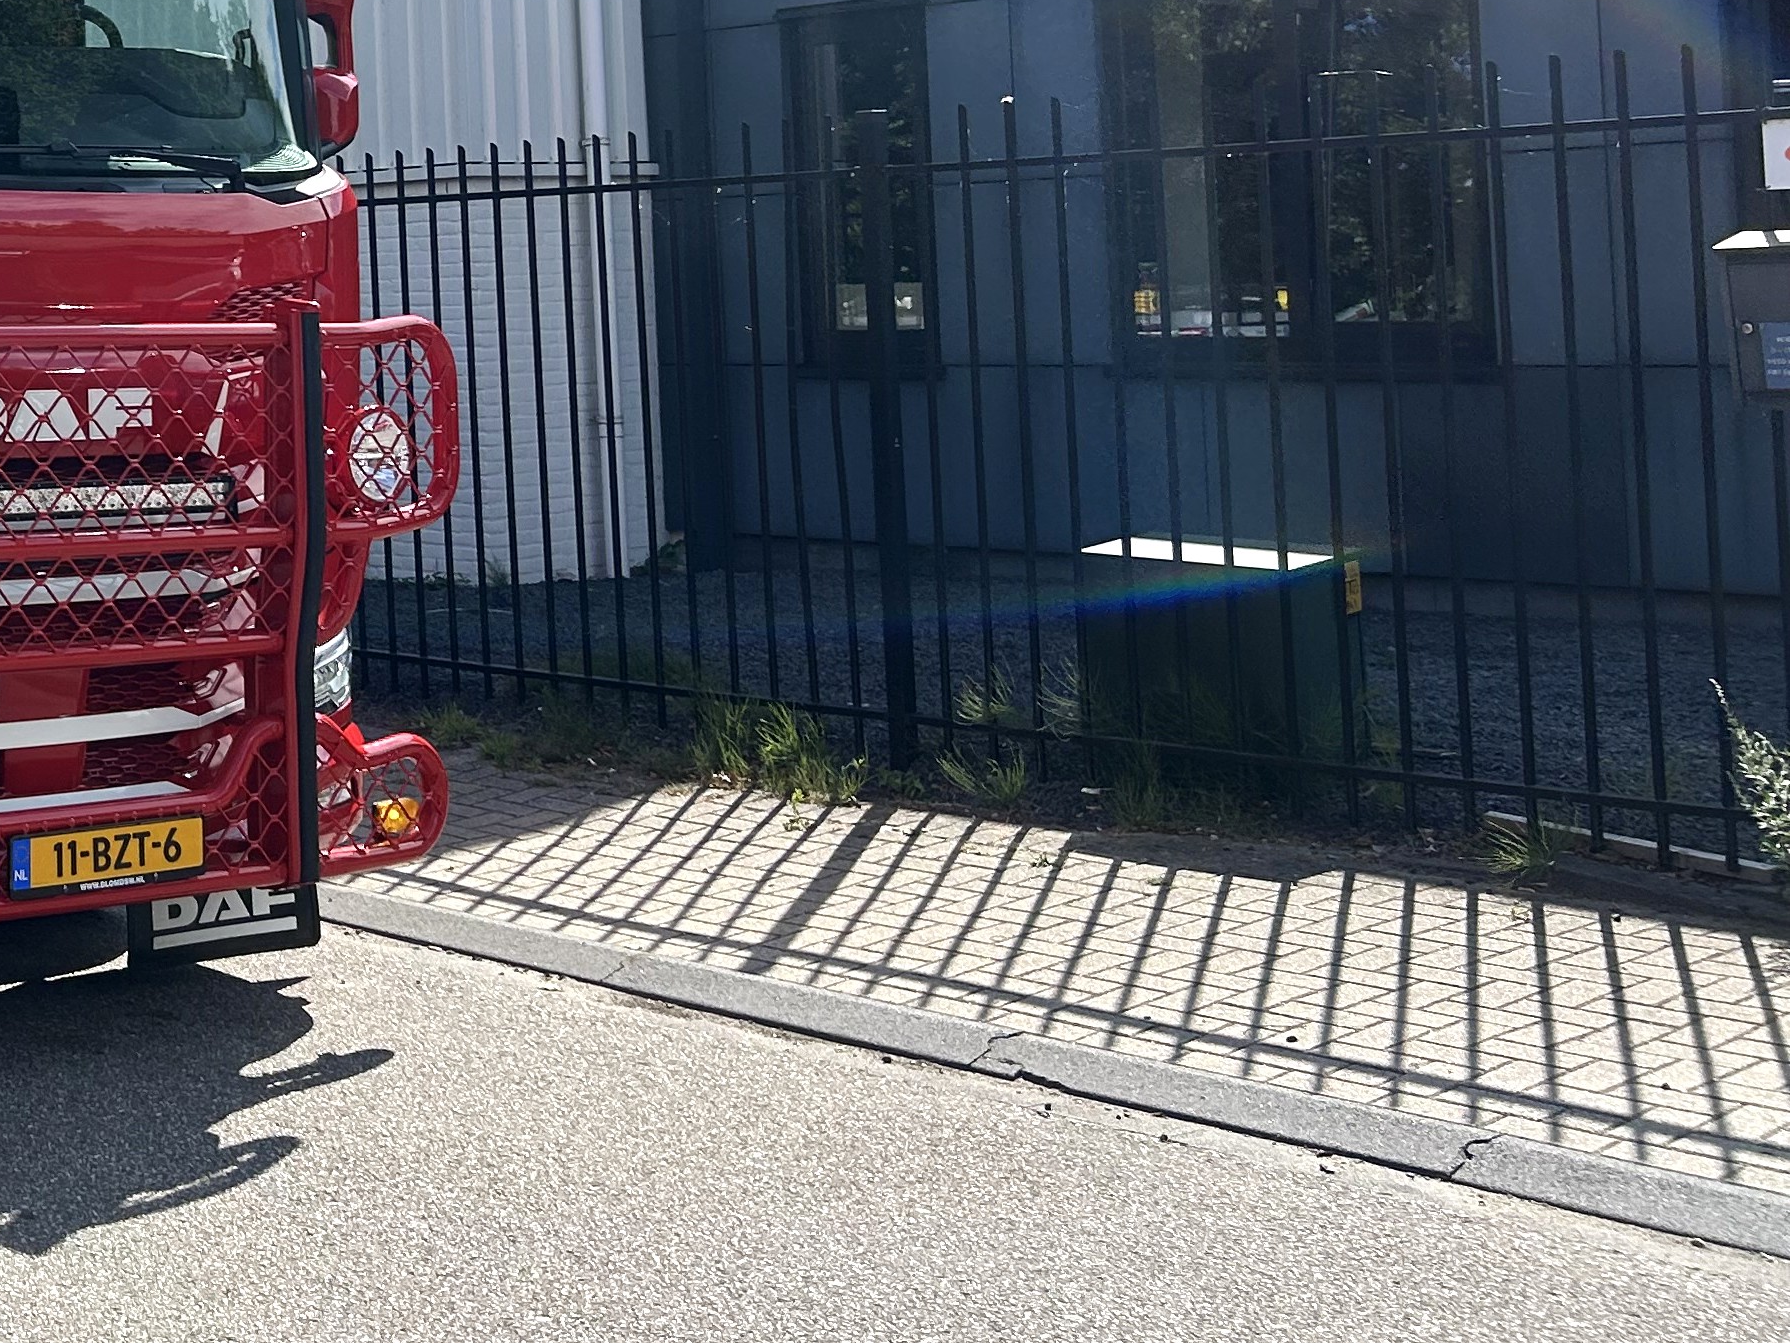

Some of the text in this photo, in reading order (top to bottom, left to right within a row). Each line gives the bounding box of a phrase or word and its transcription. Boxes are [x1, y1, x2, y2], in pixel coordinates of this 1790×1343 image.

[52, 826, 183, 878] 11-BZT-6
[13, 869, 29, 882] NL
[150, 887, 296, 932] DAF
